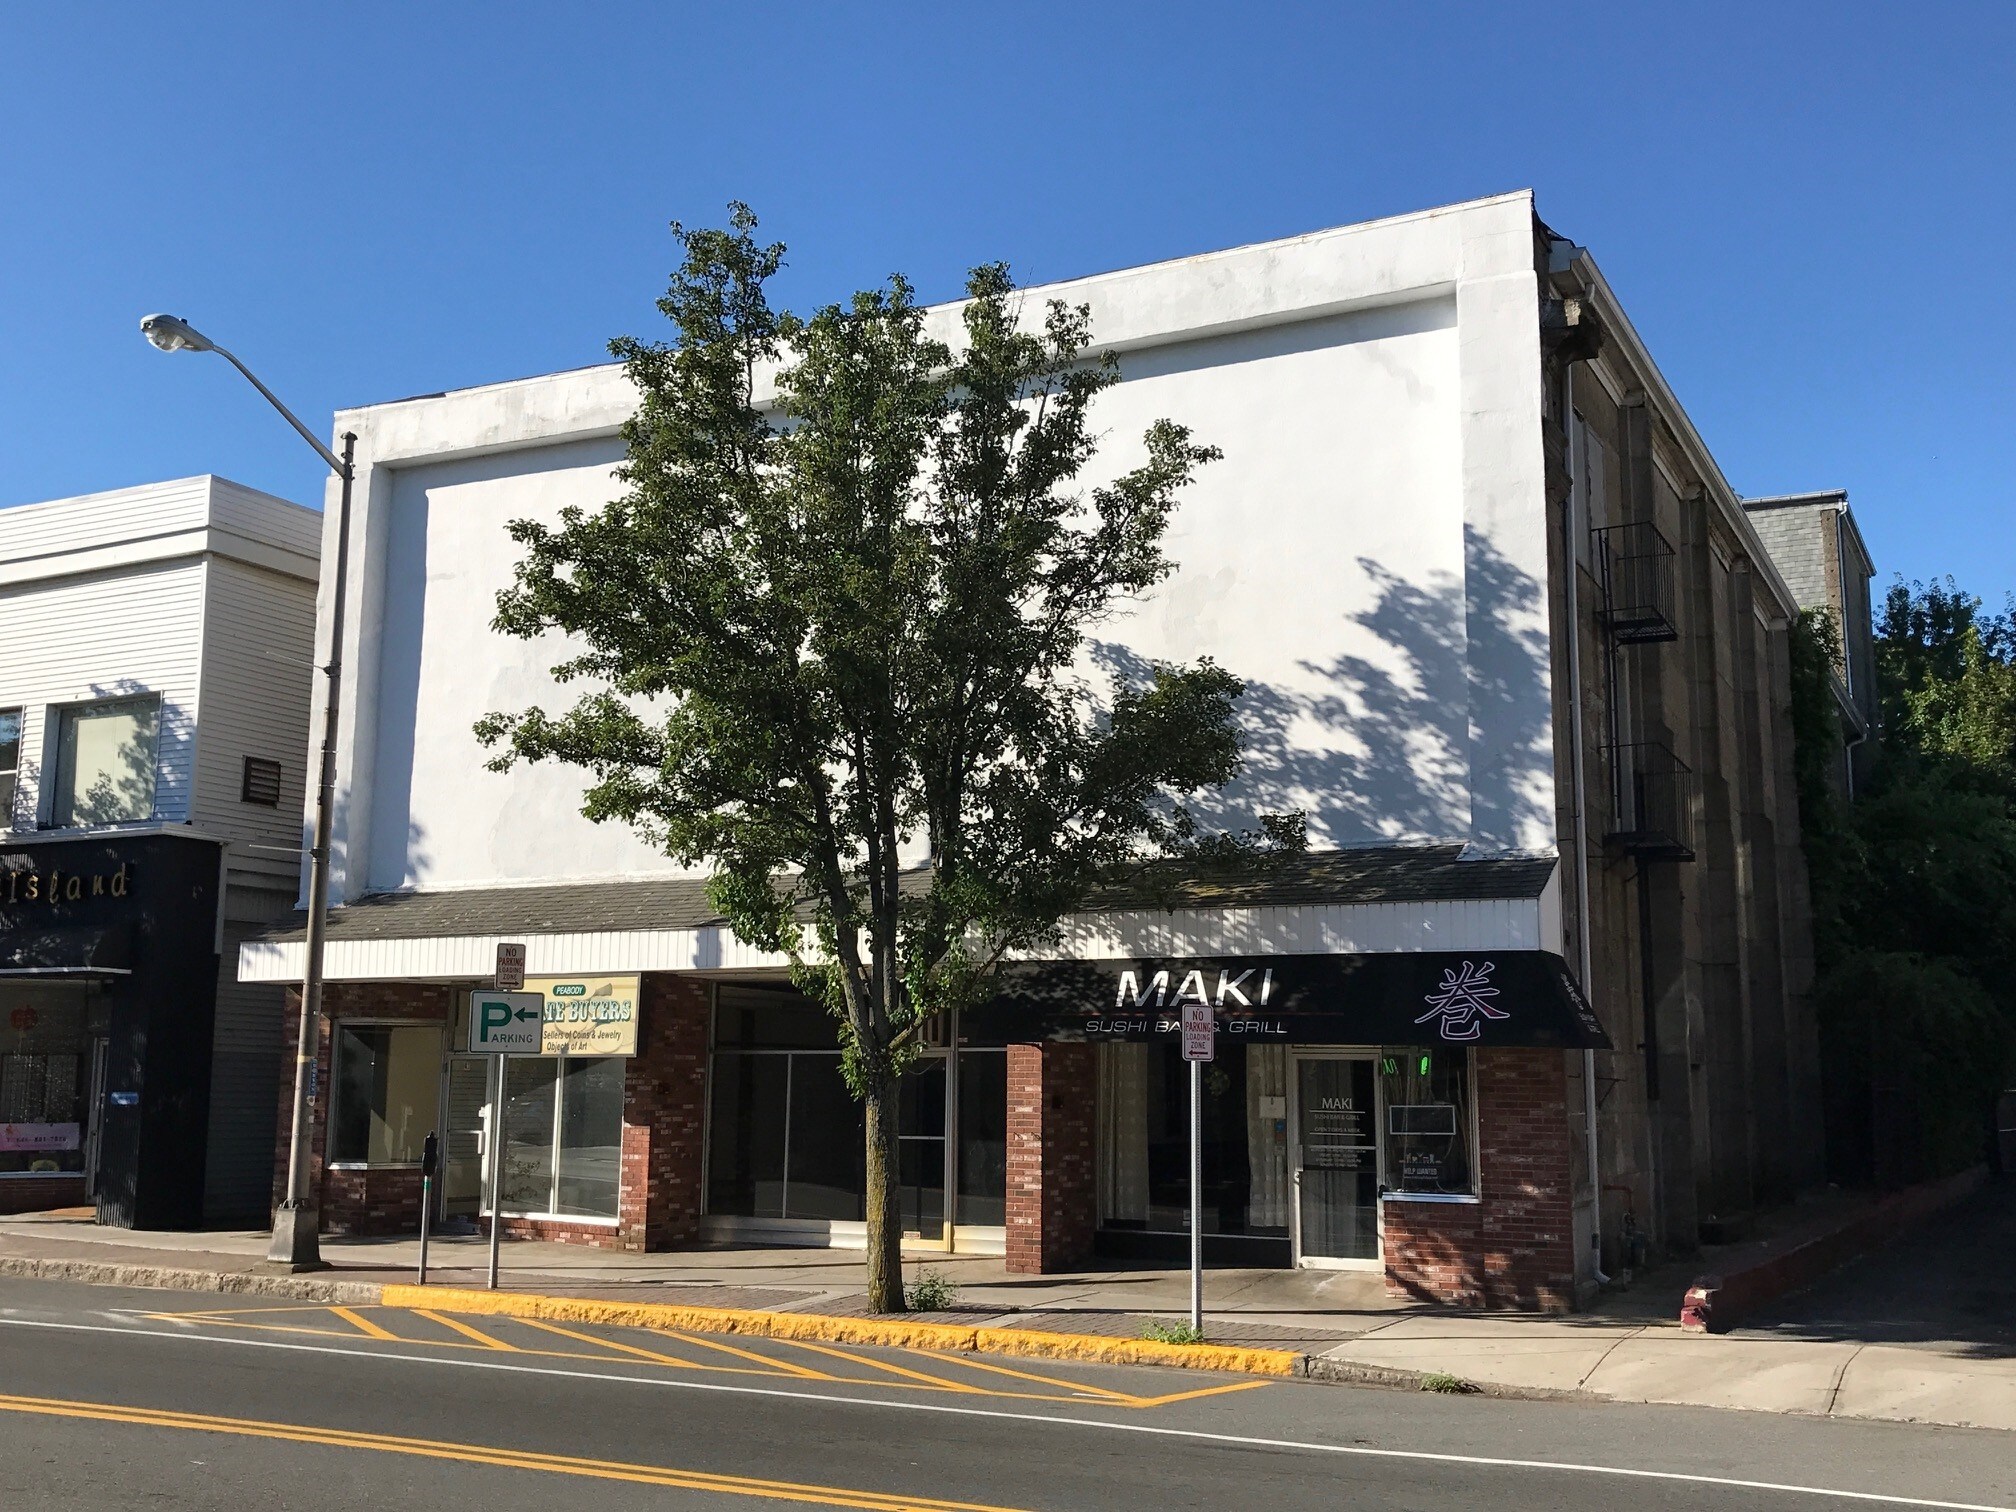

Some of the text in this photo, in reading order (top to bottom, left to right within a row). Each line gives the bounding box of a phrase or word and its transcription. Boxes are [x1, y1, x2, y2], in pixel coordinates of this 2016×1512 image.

[9, 862, 127, 904] Island
[505, 948, 517, 957] NO
[498, 958, 524, 967] PARKING
[556, 985, 583, 995] PEABODY
[1115, 968, 1273, 1007] MAKI
[569, 1000, 632, 1023] BUYERS
[1192, 1010, 1204, 1021] NO
[1085, 1020, 1147, 1032] SUSHI
[1154, 1021, 1182, 1033] BA
[1228, 1020, 1288, 1033] GRILL
[1185, 1021, 1211, 1032] PARKING
[543, 1030, 564, 1040] Sellers
[564, 1030, 572, 1040] of
[597, 1030, 621, 1041] Jewelry
[1186, 1033, 1211, 1041] LOADING
[570, 1042, 578, 1050] of
[578, 1042, 588, 1050] Art
[1191, 1041, 1206, 1050] ZONE
[1322, 1097, 1353, 1110] MAKI
